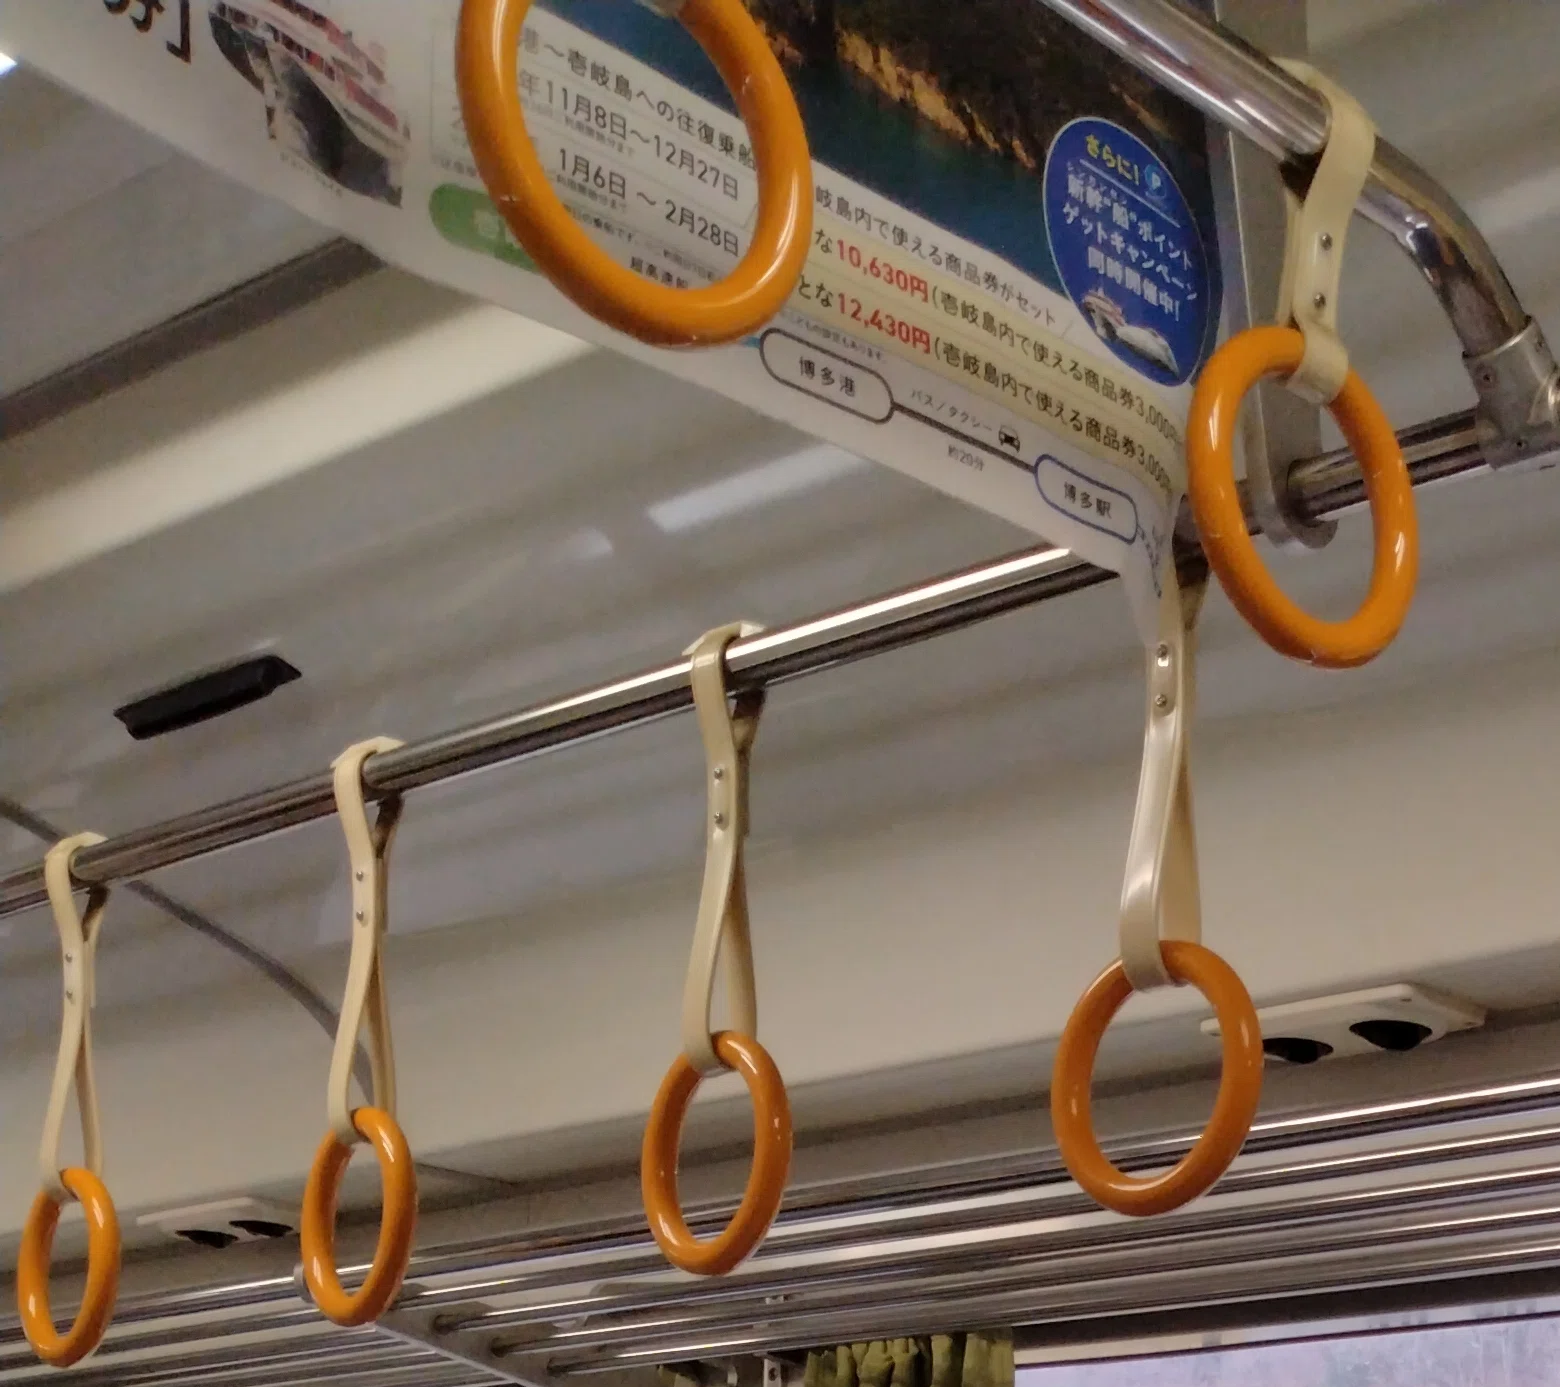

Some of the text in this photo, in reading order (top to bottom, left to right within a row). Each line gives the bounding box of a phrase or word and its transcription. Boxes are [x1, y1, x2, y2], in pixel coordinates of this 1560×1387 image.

[799, 356, 856, 398] 博多港
[1063, 481, 1113, 520] 博多駅
